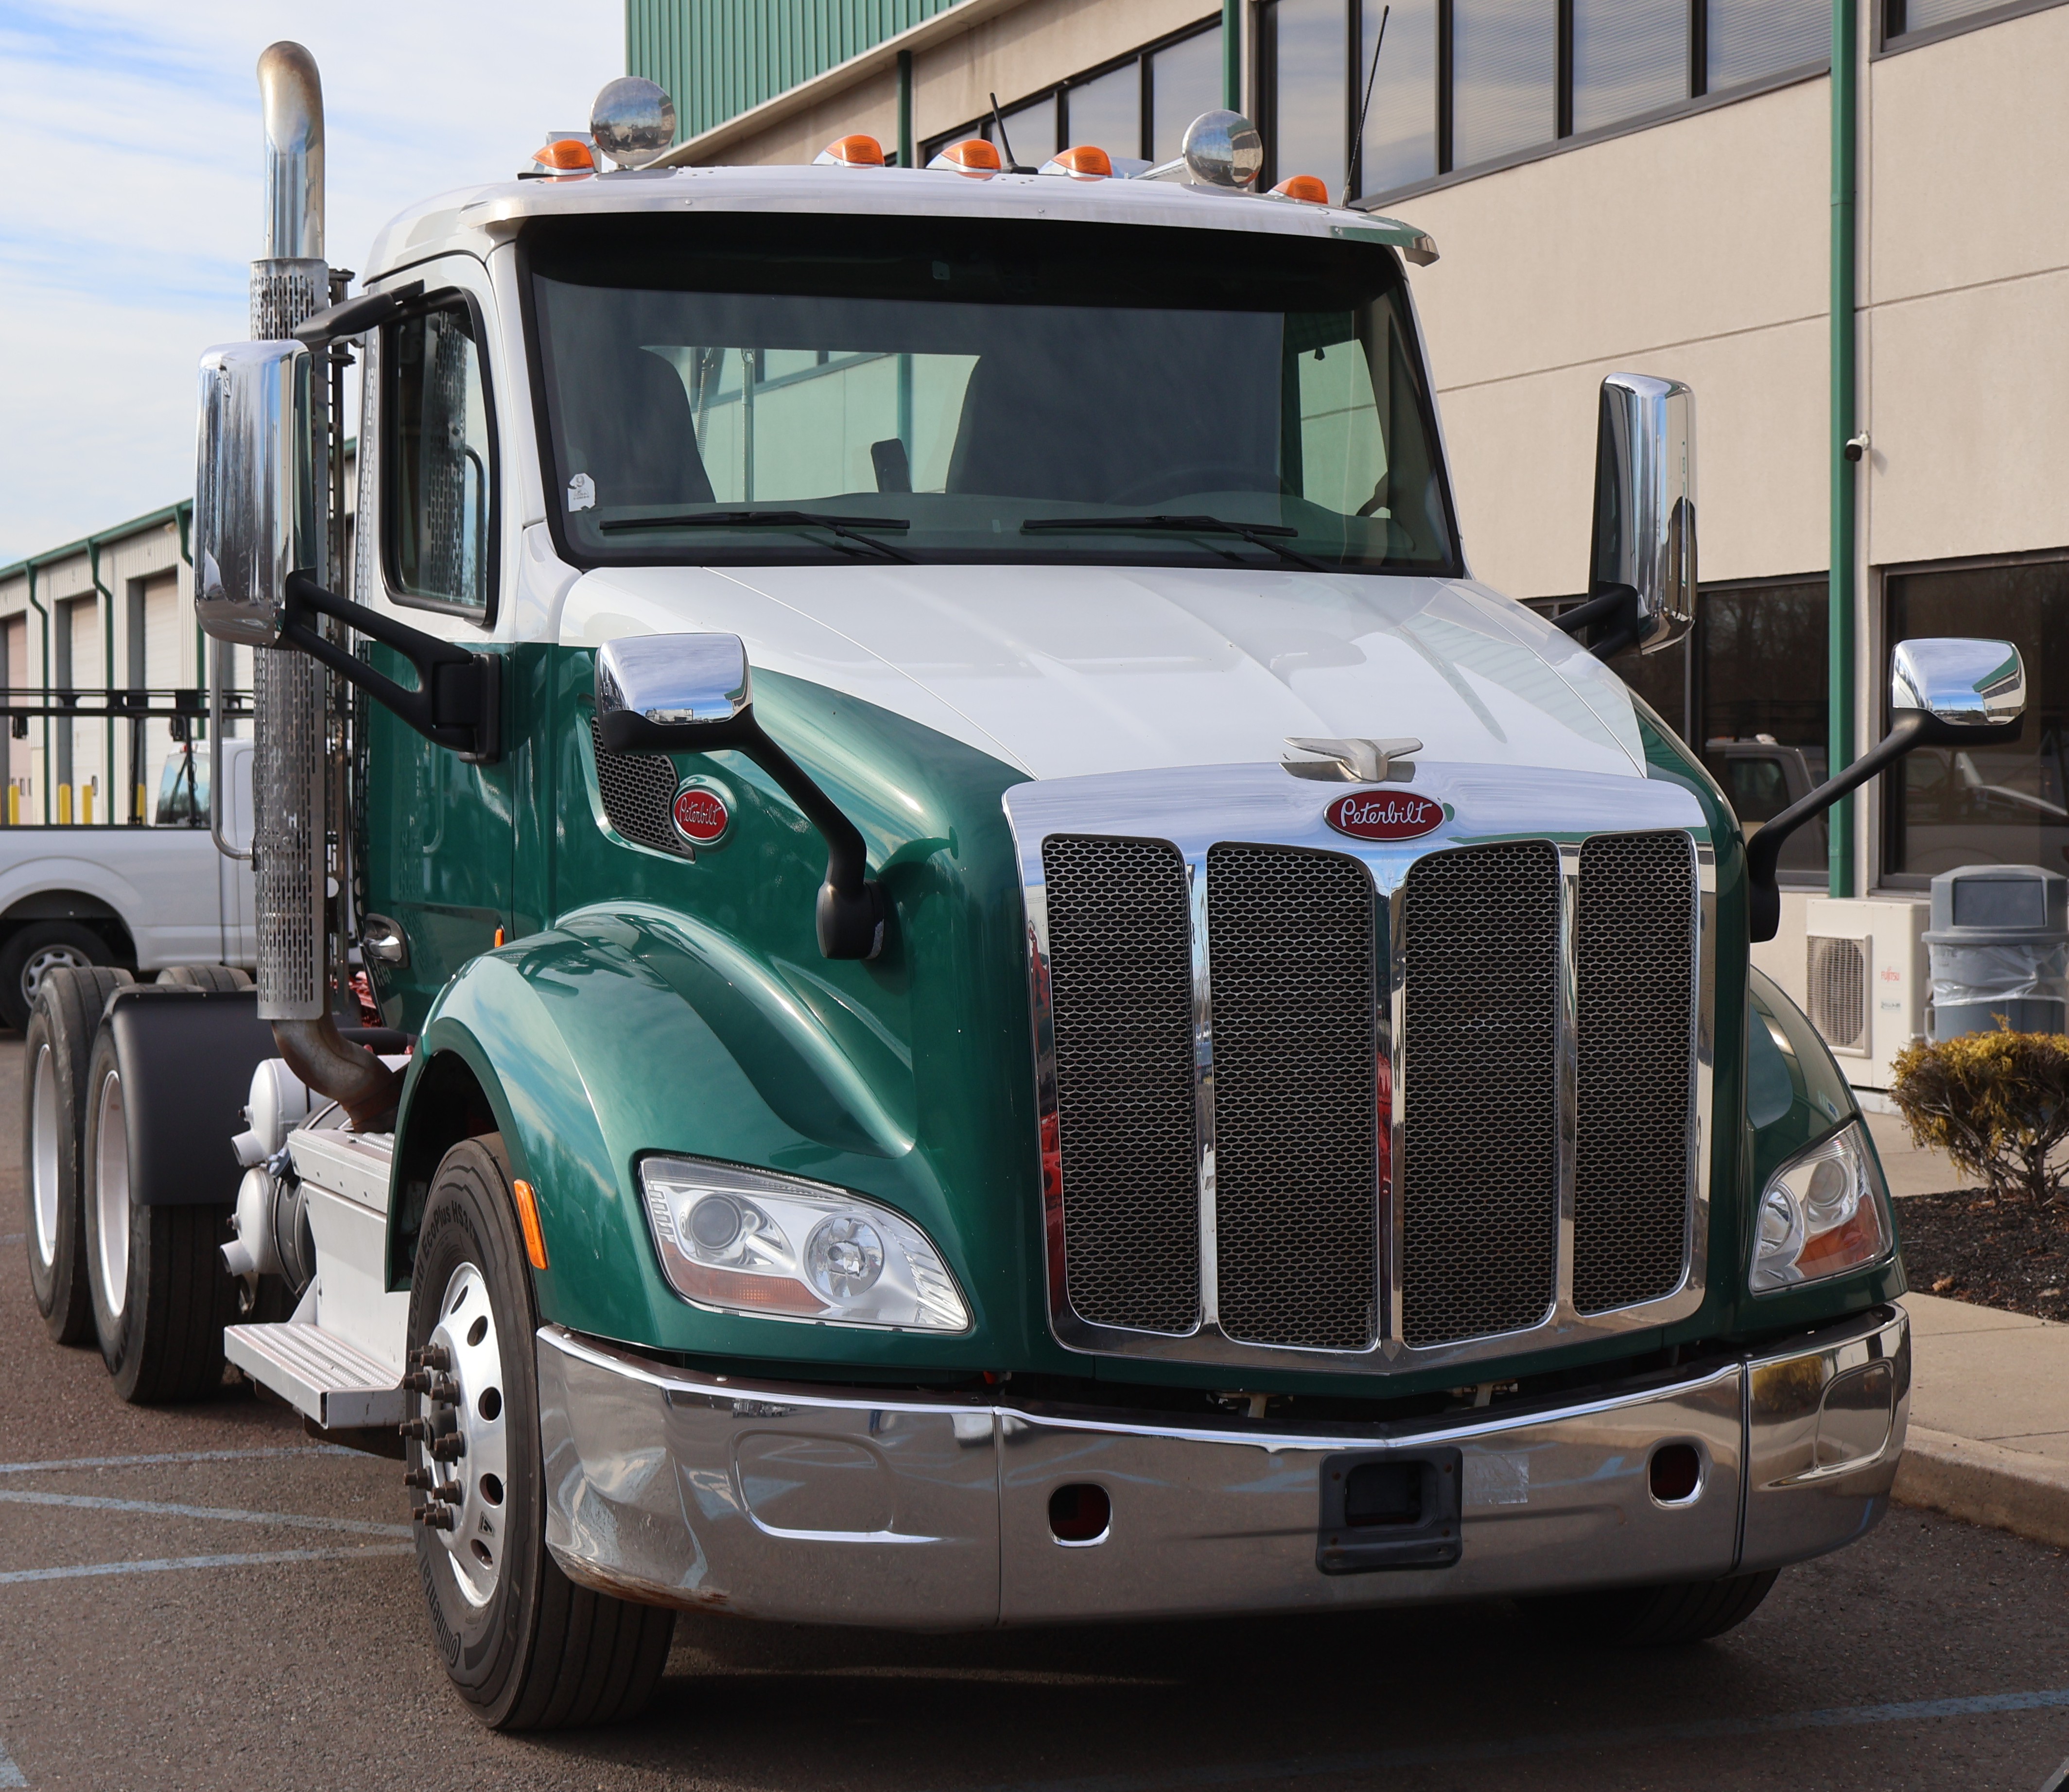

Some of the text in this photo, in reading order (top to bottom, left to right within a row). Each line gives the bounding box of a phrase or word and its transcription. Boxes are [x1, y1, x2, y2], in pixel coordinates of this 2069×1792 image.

[679, 797, 722, 826] Peterbilt
[1340, 799, 1432, 827] Peterbilt
[1880, 966, 1900, 982] FUJITSU
[409, 1254, 425, 1329] Conti
[421, 1205, 452, 1260] EcoPlus
[419, 1551, 462, 1669] Continental
